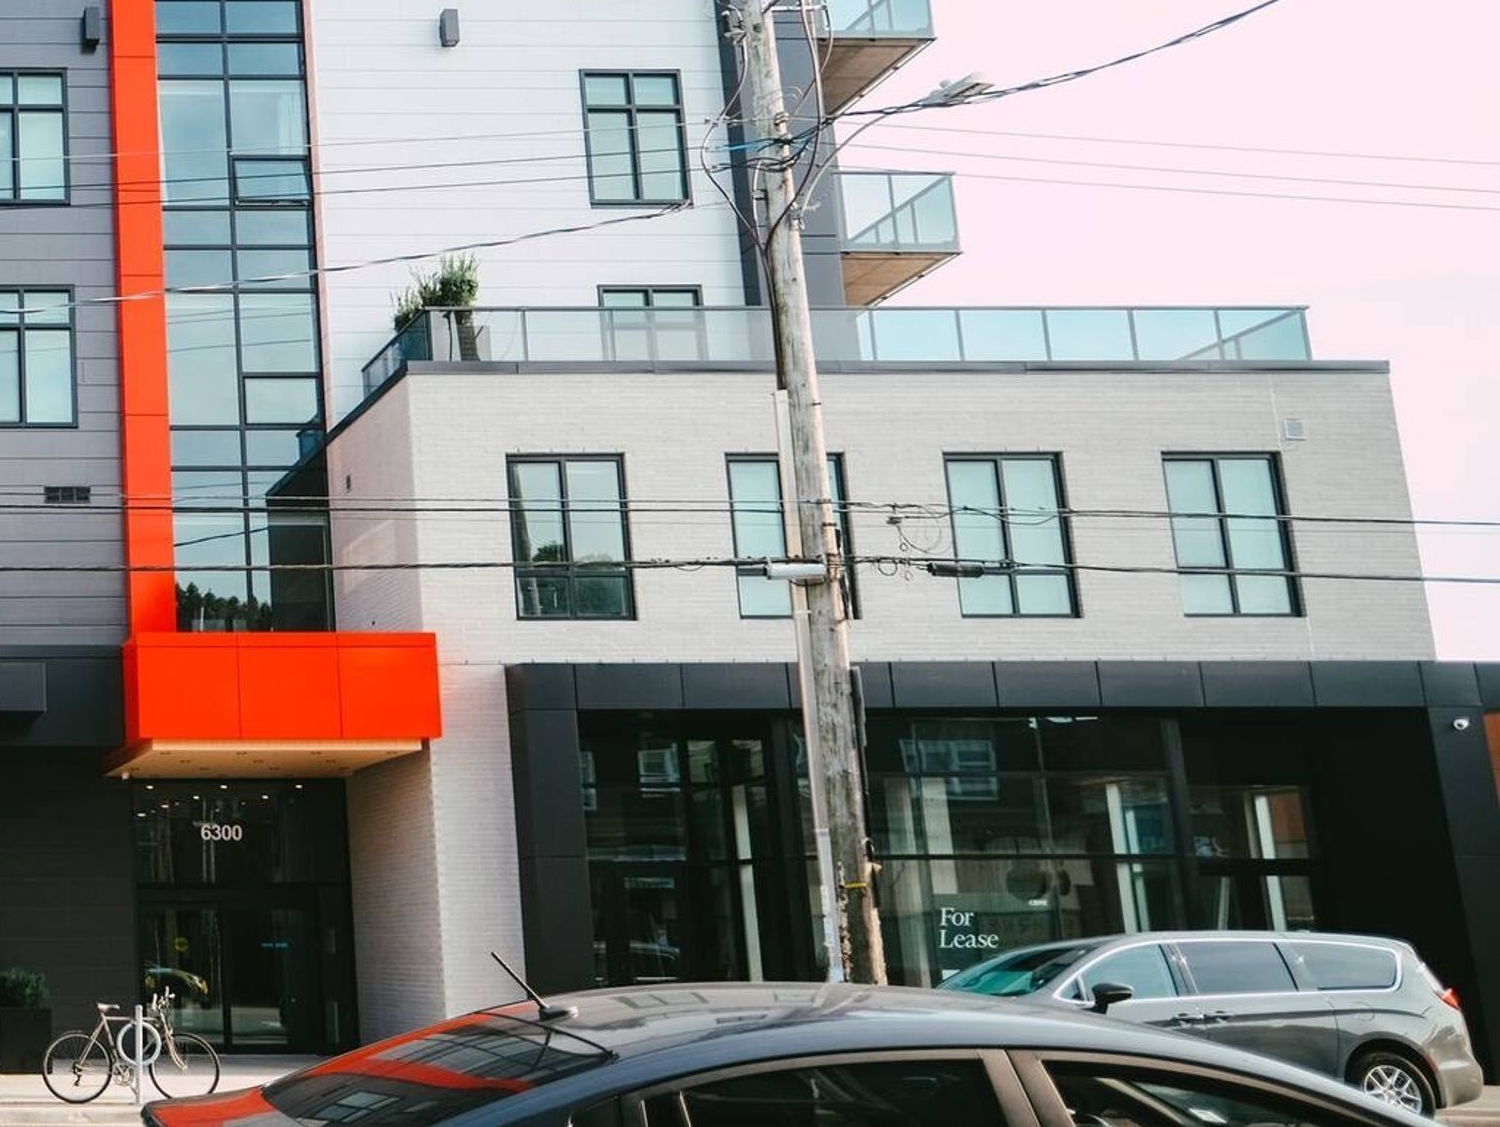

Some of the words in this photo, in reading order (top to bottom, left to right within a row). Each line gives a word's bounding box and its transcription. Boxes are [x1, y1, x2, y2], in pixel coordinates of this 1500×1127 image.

[201, 824, 242, 841] 6300
[939, 907, 974, 926] For
[939, 929, 999, 948] Lease
